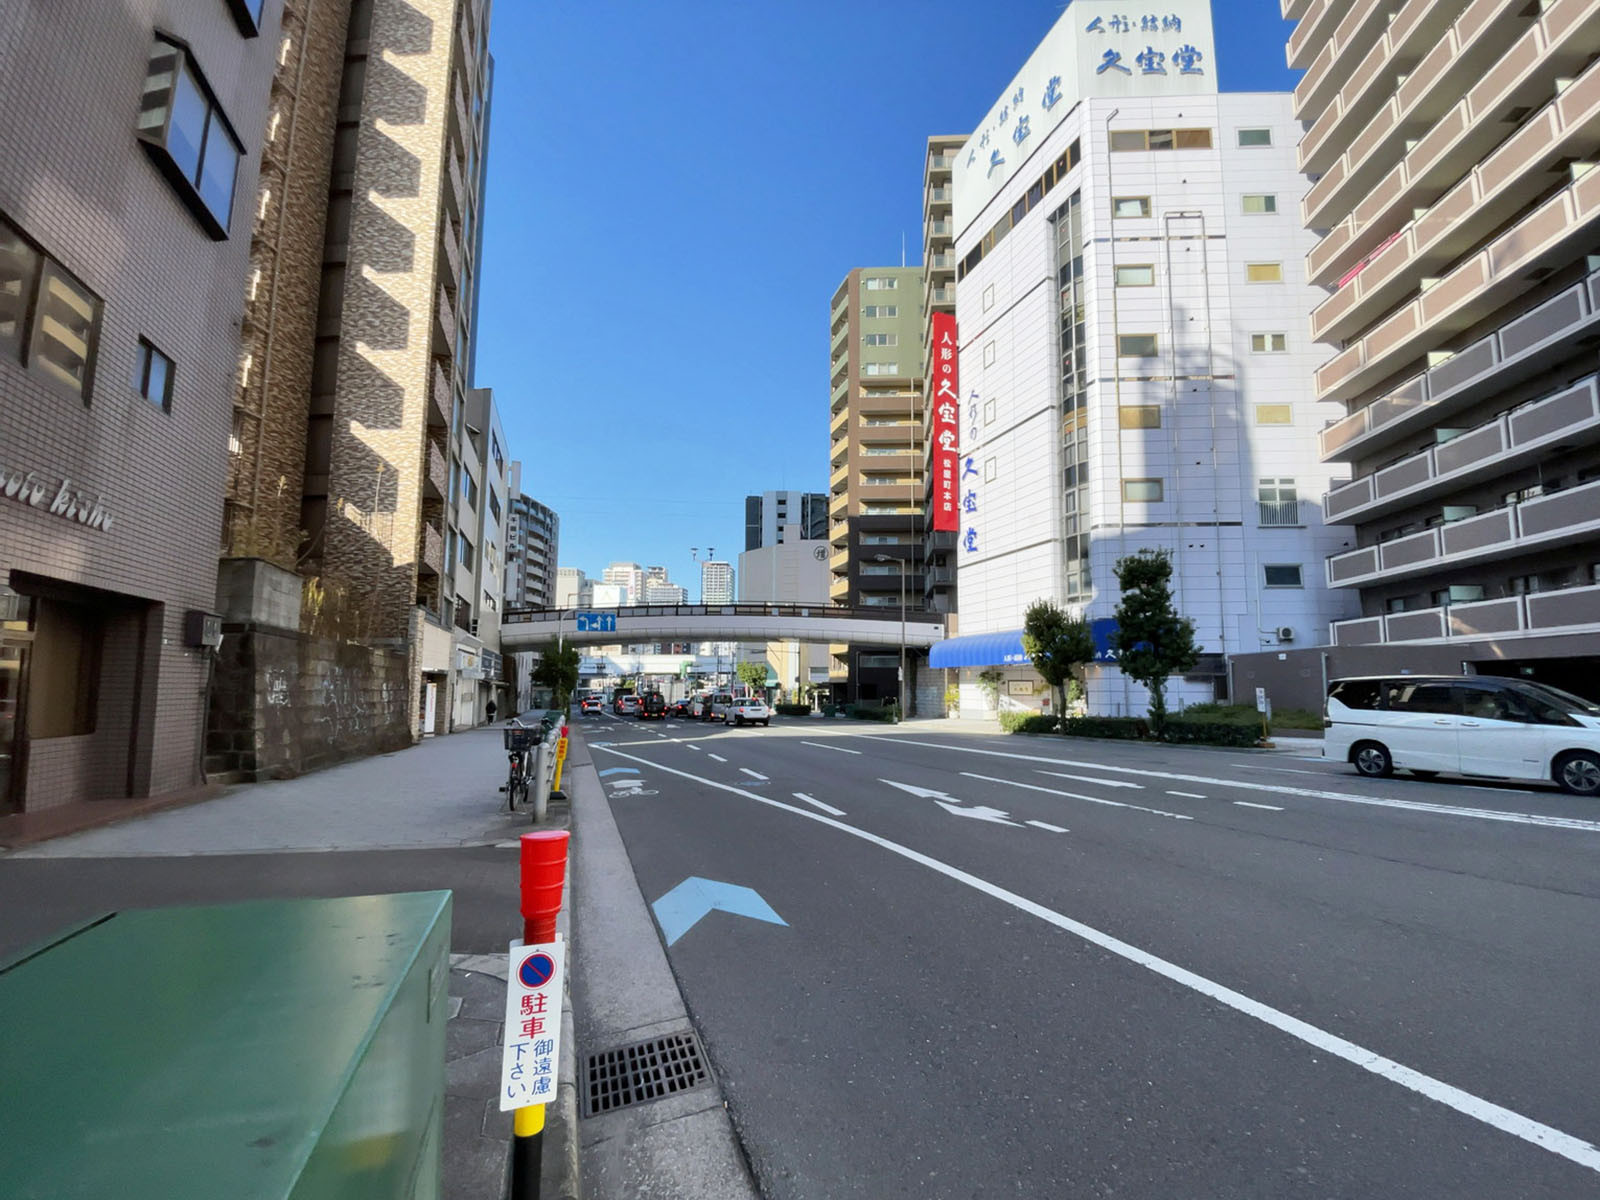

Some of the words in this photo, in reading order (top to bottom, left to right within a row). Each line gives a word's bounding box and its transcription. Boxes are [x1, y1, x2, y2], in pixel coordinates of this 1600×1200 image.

[1096, 44, 1205, 76] 久宝堂
[987, 75, 1063, 179] 久宝堂
[518, 992, 548, 1040] 駐車
[507, 1041, 530, 1098] 下さい
[531, 1039, 554, 1096] 御遠慮
